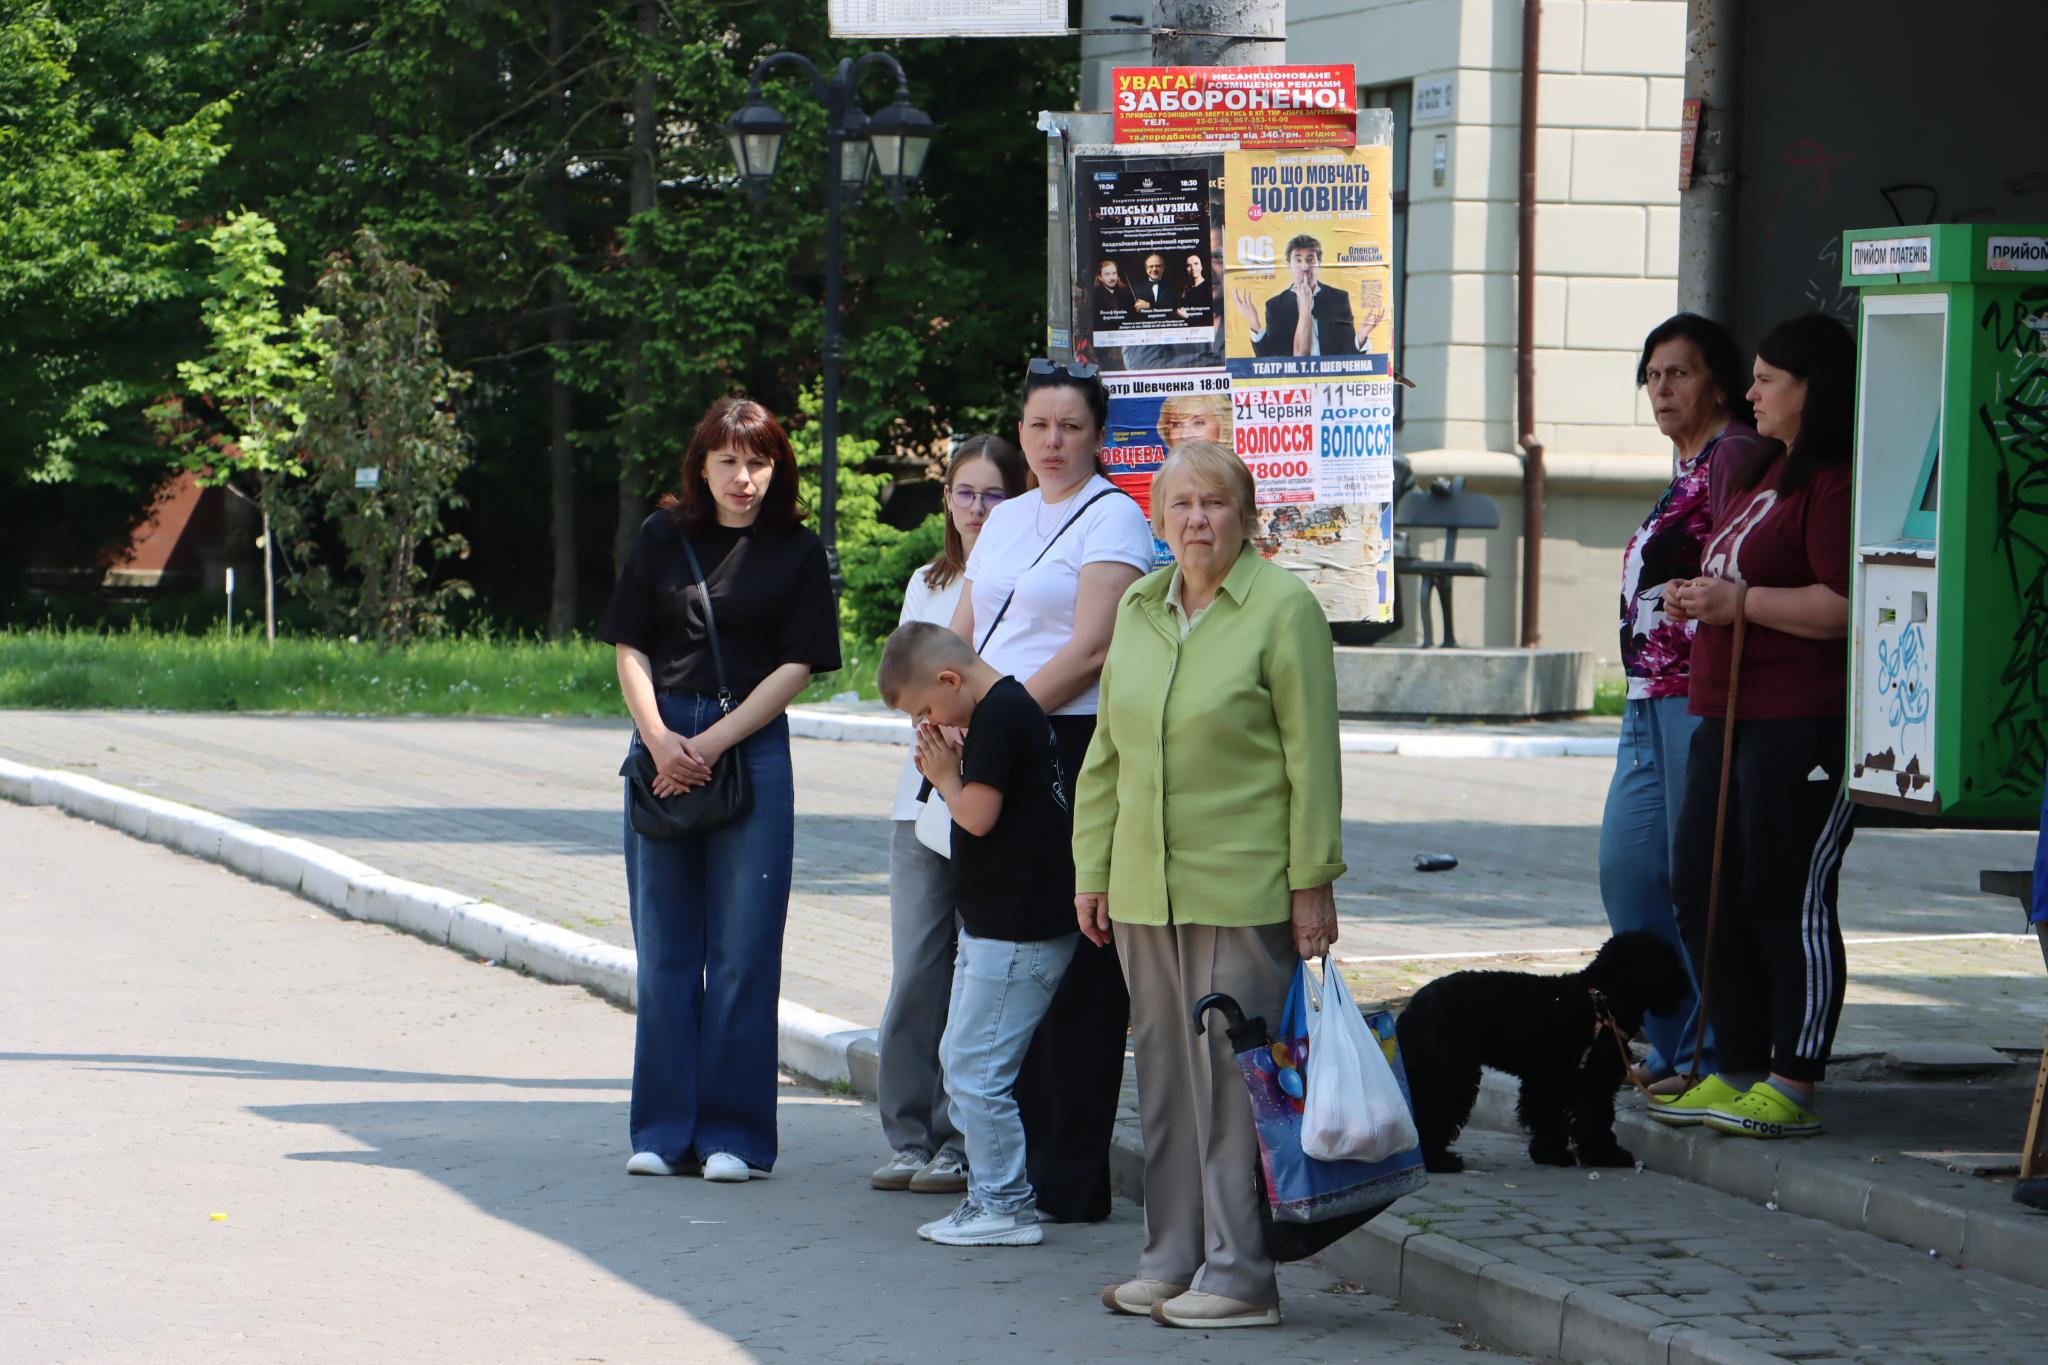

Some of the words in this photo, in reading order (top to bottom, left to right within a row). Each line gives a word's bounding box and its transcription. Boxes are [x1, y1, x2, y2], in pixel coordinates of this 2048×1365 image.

[1119, 74, 1197, 91] УВАГА!
[1208, 81, 1285, 91] РОЗМІЩЕННЯ
[1287, 80, 1342, 89] РЕКЛАМИ
[1211, 72, 1332, 82] НЕСАНКЦІОНОВАНЕ
[1118, 88, 1347, 112] ЗАБОРОНЕНО!
[1144, 133, 1202, 142] передбачає
[1205, 131, 1240, 141] штраф
[1243, 131, 1258, 139] від
[1260, 131, 1278, 139] 340
[1281, 132, 1302, 140] грн.
[1305, 130, 1337, 139] згідно
[1251, 166, 1278, 186] ПРО
[1280, 165, 1303, 187] ЩО
[1306, 164, 1370, 184] МОВЧАТЬ
[1252, 185, 1368, 213] ЧОЛОВІКИ
[1099, 204, 1155, 216] ПОЛЬСЬКА
[1125, 216, 1132, 226] В
[1133, 213, 1175, 226] УКРАЇНІ
[1237, 235, 1275, 265] 06
[1854, 244, 1887, 267] ПРИЙОМ
[1889, 246, 1928, 265] ПЛАТЕЖІВ
[1992, 242, 2048, 262] ПРИЙОМ
[1253, 362, 1282, 374] ТЕАТР
[1284, 362, 1299, 373] ІМ.
[1300, 361, 1310, 373] Т.
[1310, 361, 1319, 373] Г.
[1320, 359, 1373, 372] ШЕВЧЕНКА
[1104, 383, 1130, 395] еатр
[1133, 380, 1195, 393] Шевченка
[1199, 377, 1230, 391] 18:00
[1322, 384, 1344, 406] 11
[1346, 382, 1392, 396] ЧЕРВНЯ
[1235, 389, 1312, 405] УВАГА!
[1237, 405, 1254, 420] 21
[1257, 404, 1312, 422] Червня
[1320, 407, 1391, 421] ДОРОГО
[1235, 424, 1313, 454] ВОЛОССЯ
[1321, 424, 1391, 458] ВОЛОССЯ
[1099, 445, 1165, 468] ОВЦЕВА
[1742, 1118, 1784, 1136] crocs
